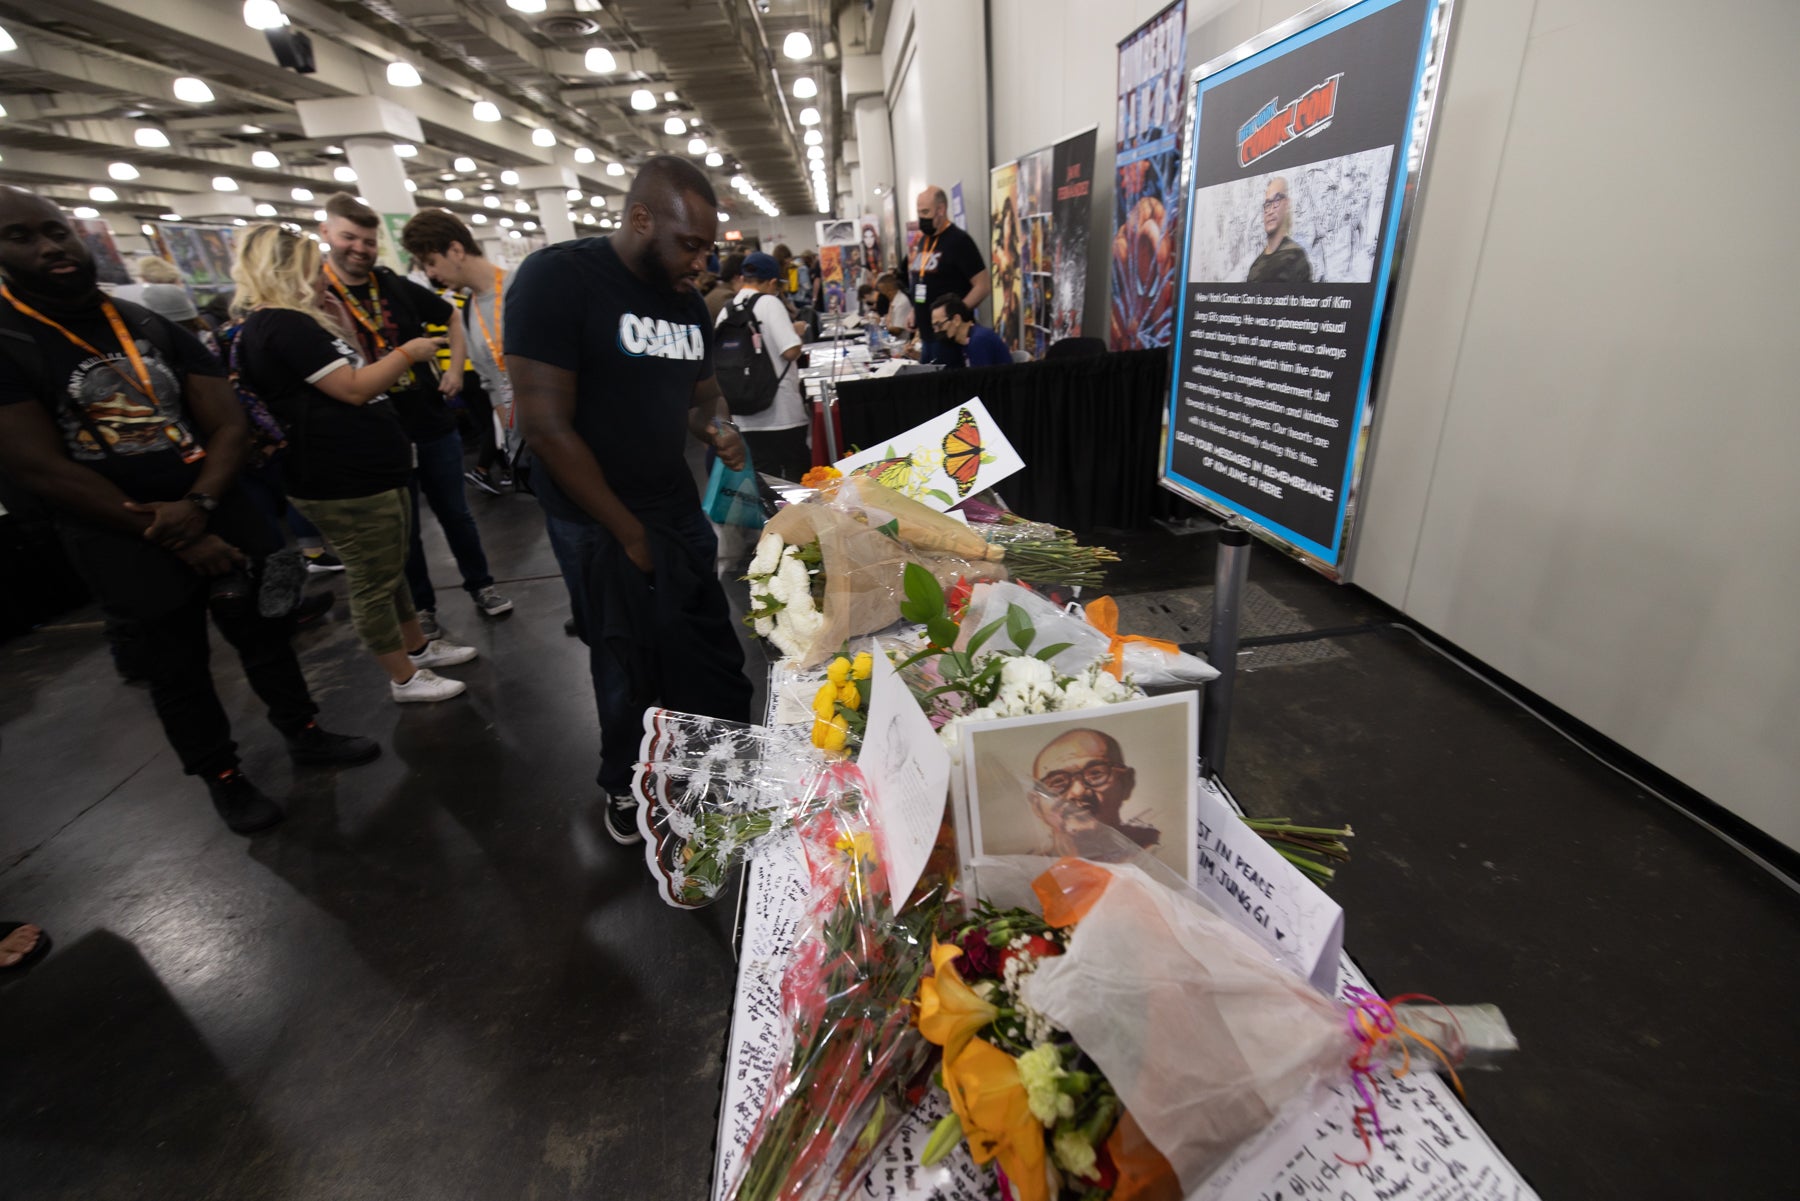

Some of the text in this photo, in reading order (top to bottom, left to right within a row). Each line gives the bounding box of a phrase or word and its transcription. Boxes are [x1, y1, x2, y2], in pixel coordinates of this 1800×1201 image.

[1220, 292, 1241, 304] Comic
[1241, 293, 1256, 304] Con
[1256, 293, 1262, 305] is
[1262, 296, 1273, 305] so
[1273, 295, 1289, 306] sad
[1289, 295, 1299, 306] to
[1299, 295, 1320, 307] hear
[1320, 296, 1332, 308] of
[1331, 296, 1351, 309] Kim
[619, 313, 705, 360] OSAKA
[1243, 314, 1254, 325] He
[1254, 317, 1269, 326] was
[1275, 317, 1319, 334] pioneering
[1320, 320, 1347, 333] visual
[1237, 333, 1250, 344] him
[1259, 338, 1272, 347] our
[1271, 340, 1297, 352] events
[1297, 343, 1315, 354] was
[1315, 343, 1347, 360] always
[1257, 358, 1278, 370] watch
[1278, 360, 1294, 372] him
[1294, 363, 1310, 376] live
[1309, 366, 1334, 380] draw
[1313, 389, 1331, 402] but
[1242, 396, 1285, 414] appreciation
[1285, 407, 1302, 418] and
[1302, 408, 1339, 428] kindness
[1271, 422, 1287, 435] Our
[1287, 426, 1313, 443] hearts
[1313, 437, 1330, 448] are
[1175, 430, 1335, 502] LEAVE YOUR MESSAGES IN REMEMBRANCE
[1260, 440, 1284, 457] during
[1284, 446, 1299, 460] this
[1299, 451, 1319, 467] time.
[1202, 456, 1283, 499] OF KIM JUNG GI HERE
[1198, 851, 1215, 876] IM
[1216, 868, 1252, 914] JUNG
[1215, 838, 1232, 862] IN
[1235, 855, 1276, 900] PEACE
